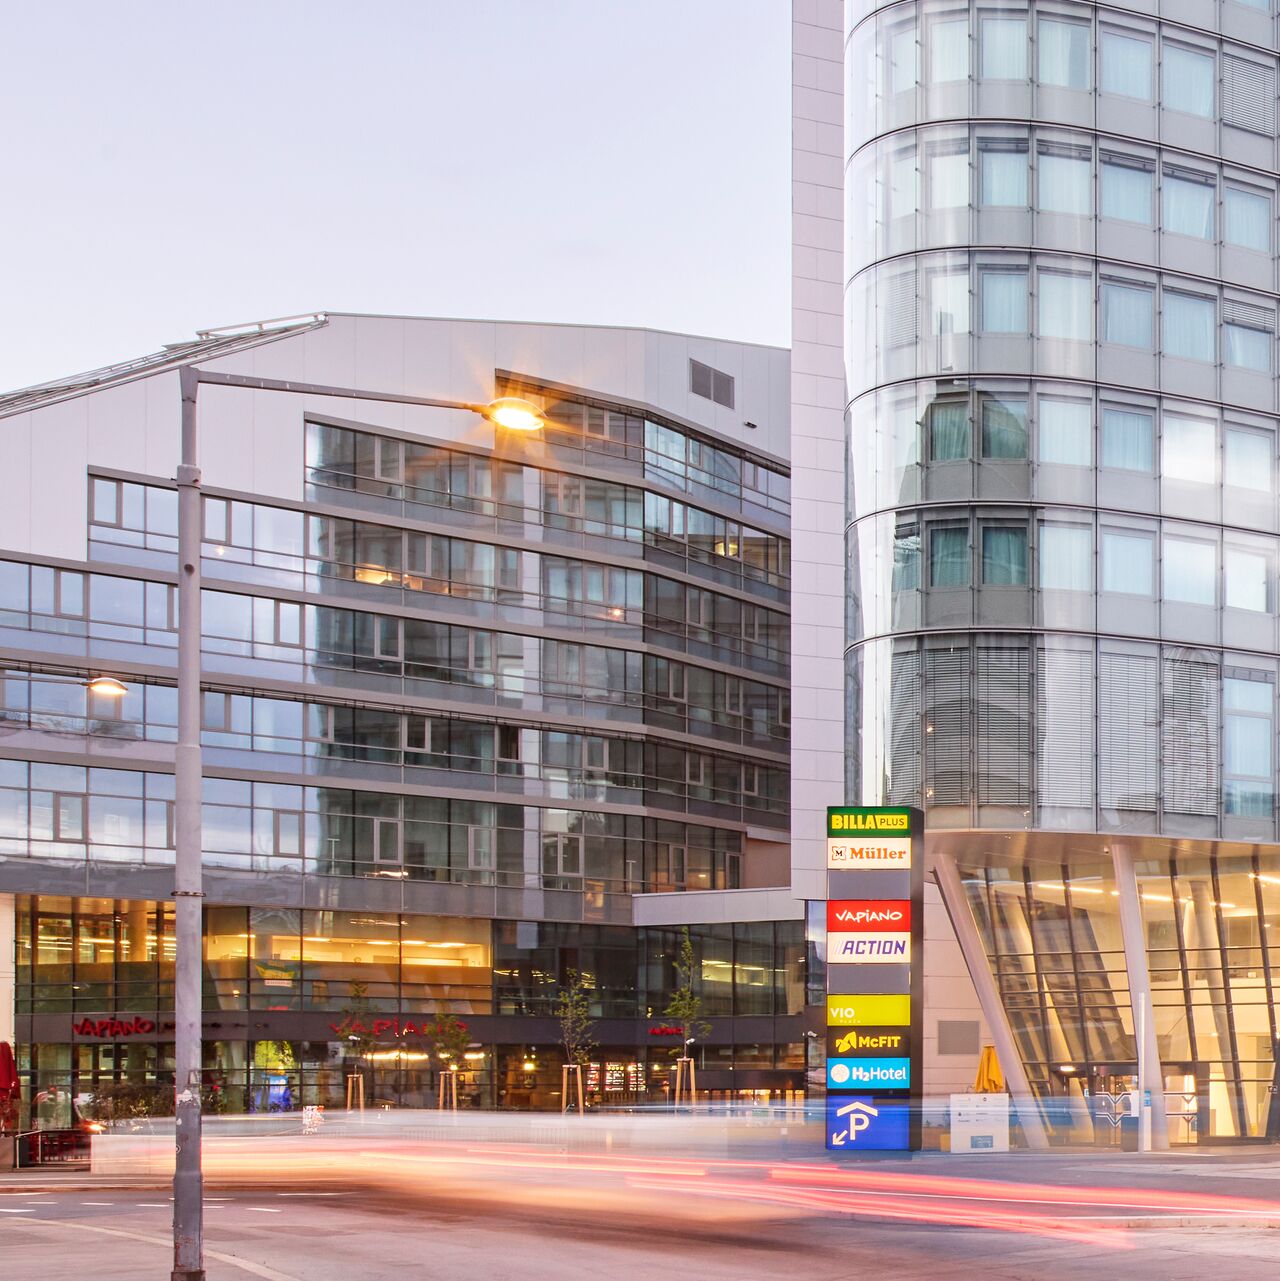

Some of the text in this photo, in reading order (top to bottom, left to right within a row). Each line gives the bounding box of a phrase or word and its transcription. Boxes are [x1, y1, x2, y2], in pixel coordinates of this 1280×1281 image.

[831, 814, 905, 830] BILLA PLUS
[849, 847, 906, 860] Müller
[841, 940, 906, 955] ACTION
[830, 1007, 856, 1019] VIO
[858, 1036, 902, 1048] McFIT
[851, 1066, 907, 1082] H2Hotel
[850, 1113, 870, 1141] P
